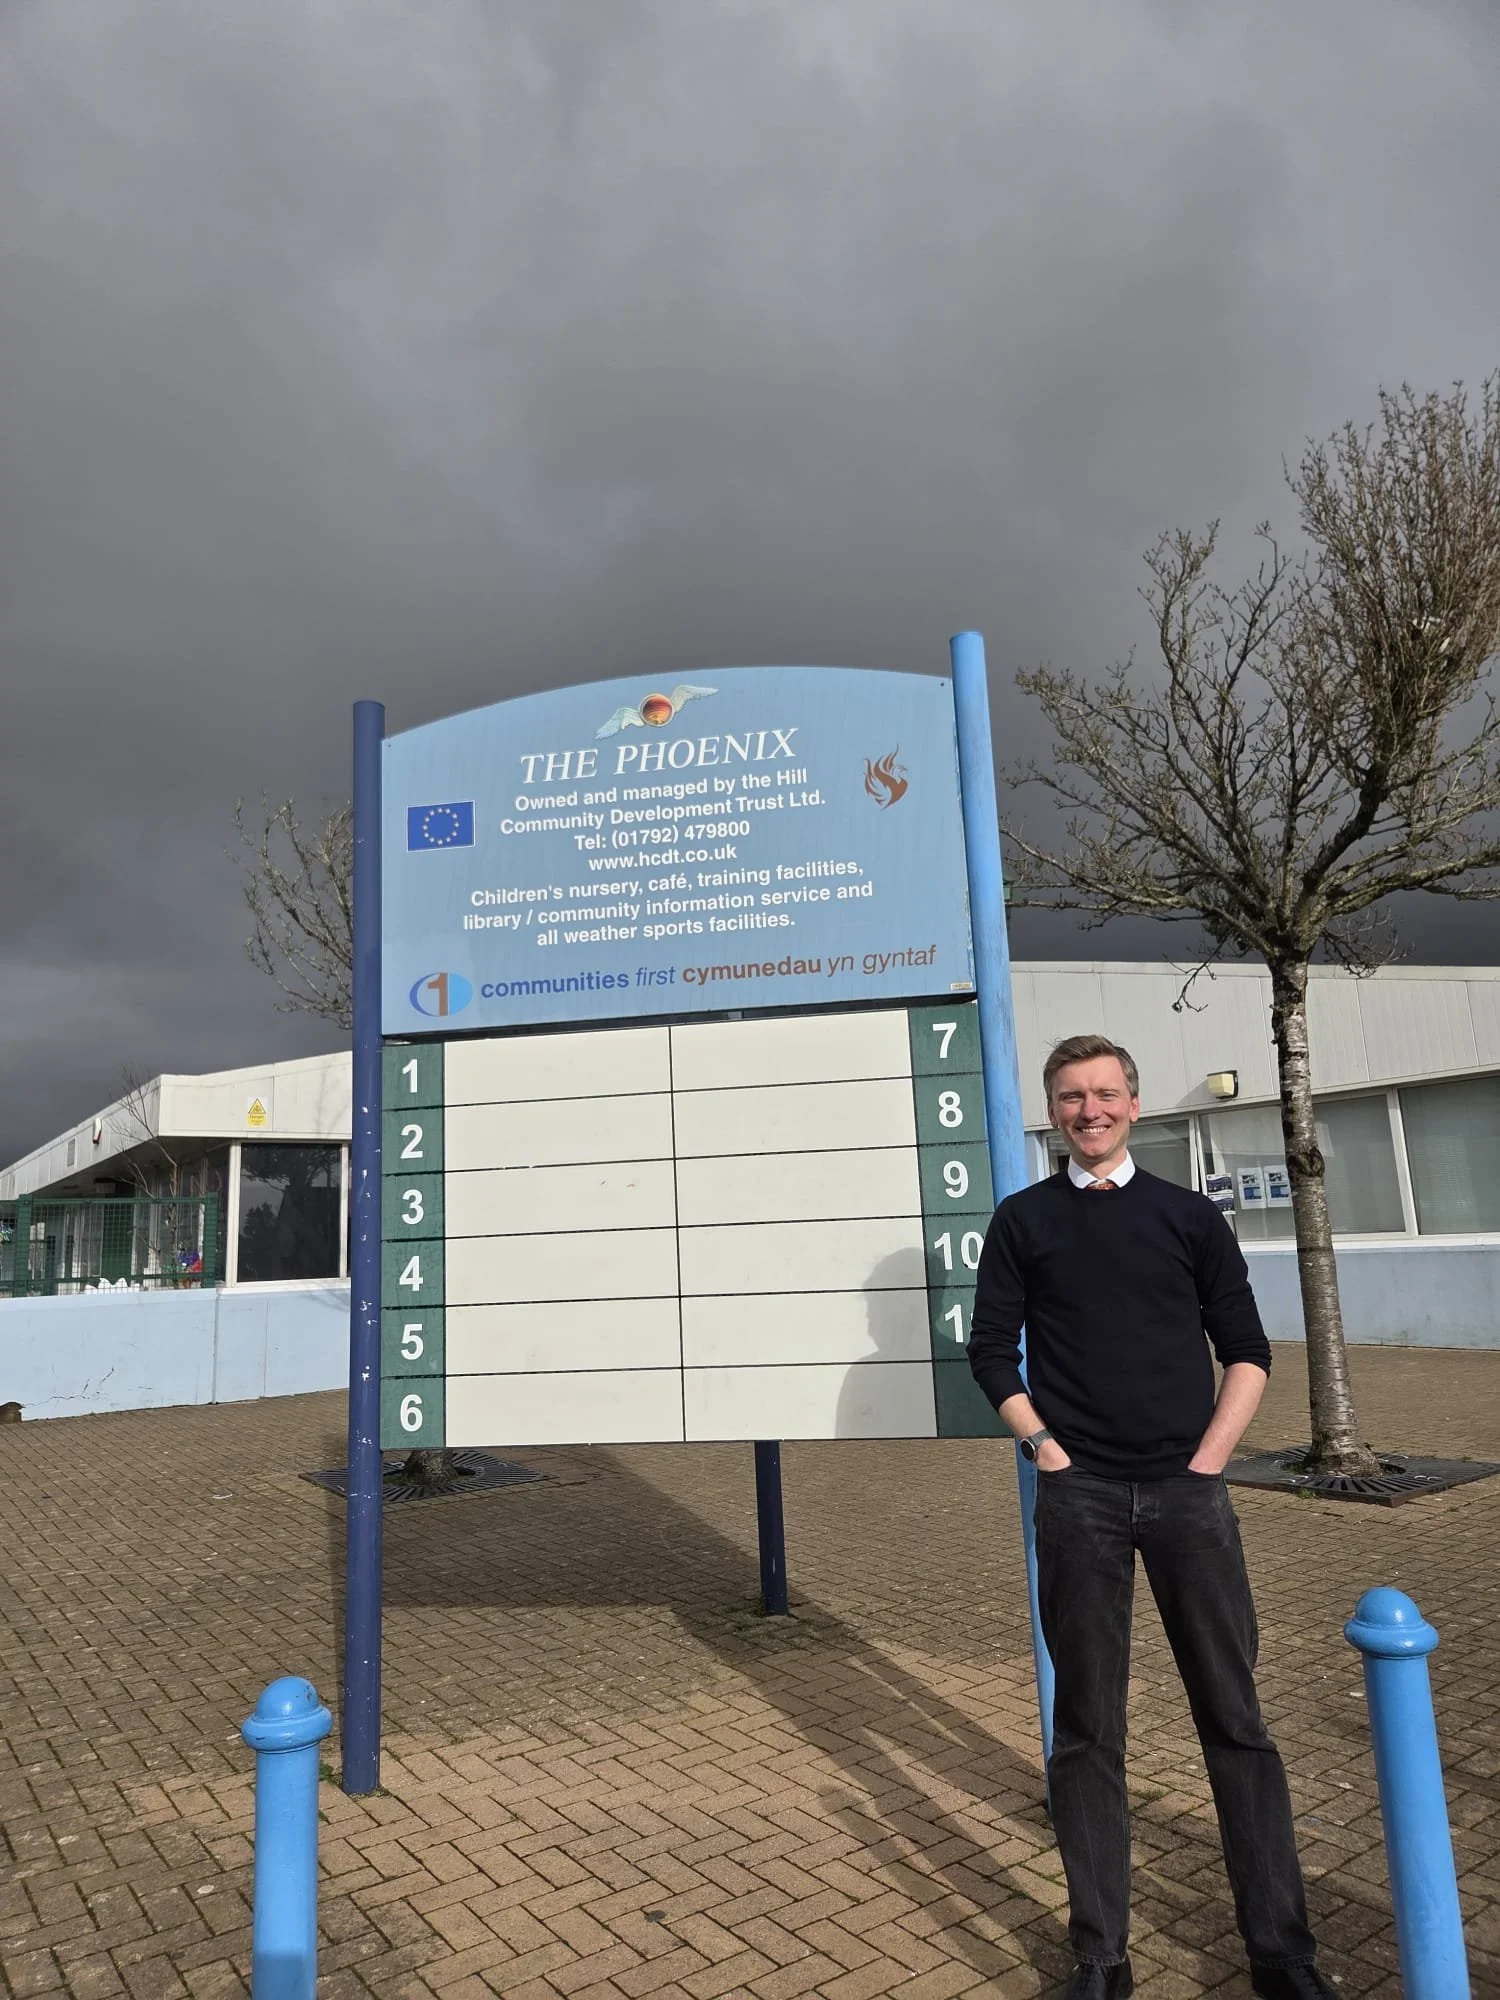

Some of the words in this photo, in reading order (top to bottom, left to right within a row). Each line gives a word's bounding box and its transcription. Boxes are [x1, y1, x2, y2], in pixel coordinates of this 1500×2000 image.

[520, 748, 599, 784] THE
[613, 728, 799, 775] PHOENIX
[515, 791, 578, 811] Owned
[583, 788, 617, 806] and
[623, 777, 708, 801] managed
[714, 773, 736, 795] by
[741, 772, 772, 790] the
[777, 768, 807, 786] Hill
[500, 811, 604, 834] Community
[610, 796, 732, 822] Development
[735, 794, 784, 813] Trust
[789, 789, 826, 808] Ltd.
[574, 831, 607, 850] Tel:
[612, 825, 679, 849] (01792)
[684, 820, 750, 840] 479800
[588, 844, 737, 871] www.hcdt.co.uk
[471, 885, 564, 907] Children's
[569, 879, 643, 898] nursery,
[648, 872, 693, 892] café,
[697, 868, 770, 887] training
[776, 860, 864, 880] facilities,
[463, 912, 521, 930] library
[526, 909, 533, 926] /
[538, 902, 641, 924] community
[646, 892, 755, 916] information
[760, 886, 831, 906] service
[836, 881, 873, 900] and
[537, 929, 558, 946] all
[564, 924, 638, 944] weather
[643, 918, 704, 941] sports
[709, 912, 796, 932] facilities.
[480, 971, 630, 998] communities
[635, 965, 677, 987] first
[682, 956, 823, 985] cymunedau
[827, 957, 855, 978] yn
[861, 944, 937, 975] gyntaf
[932, 1022, 957, 1059] 7
[402, 1058, 418, 1093] 1
[938, 1091, 963, 1128] 8
[400, 1124, 424, 1160] 2
[943, 1160, 969, 1198] 9
[401, 1189, 424, 1225] 3
[934, 1231, 984, 1271] 10
[399, 1255, 424, 1291] 4
[400, 1323, 424, 1360] 5
[400, 1394, 423, 1432] 6
